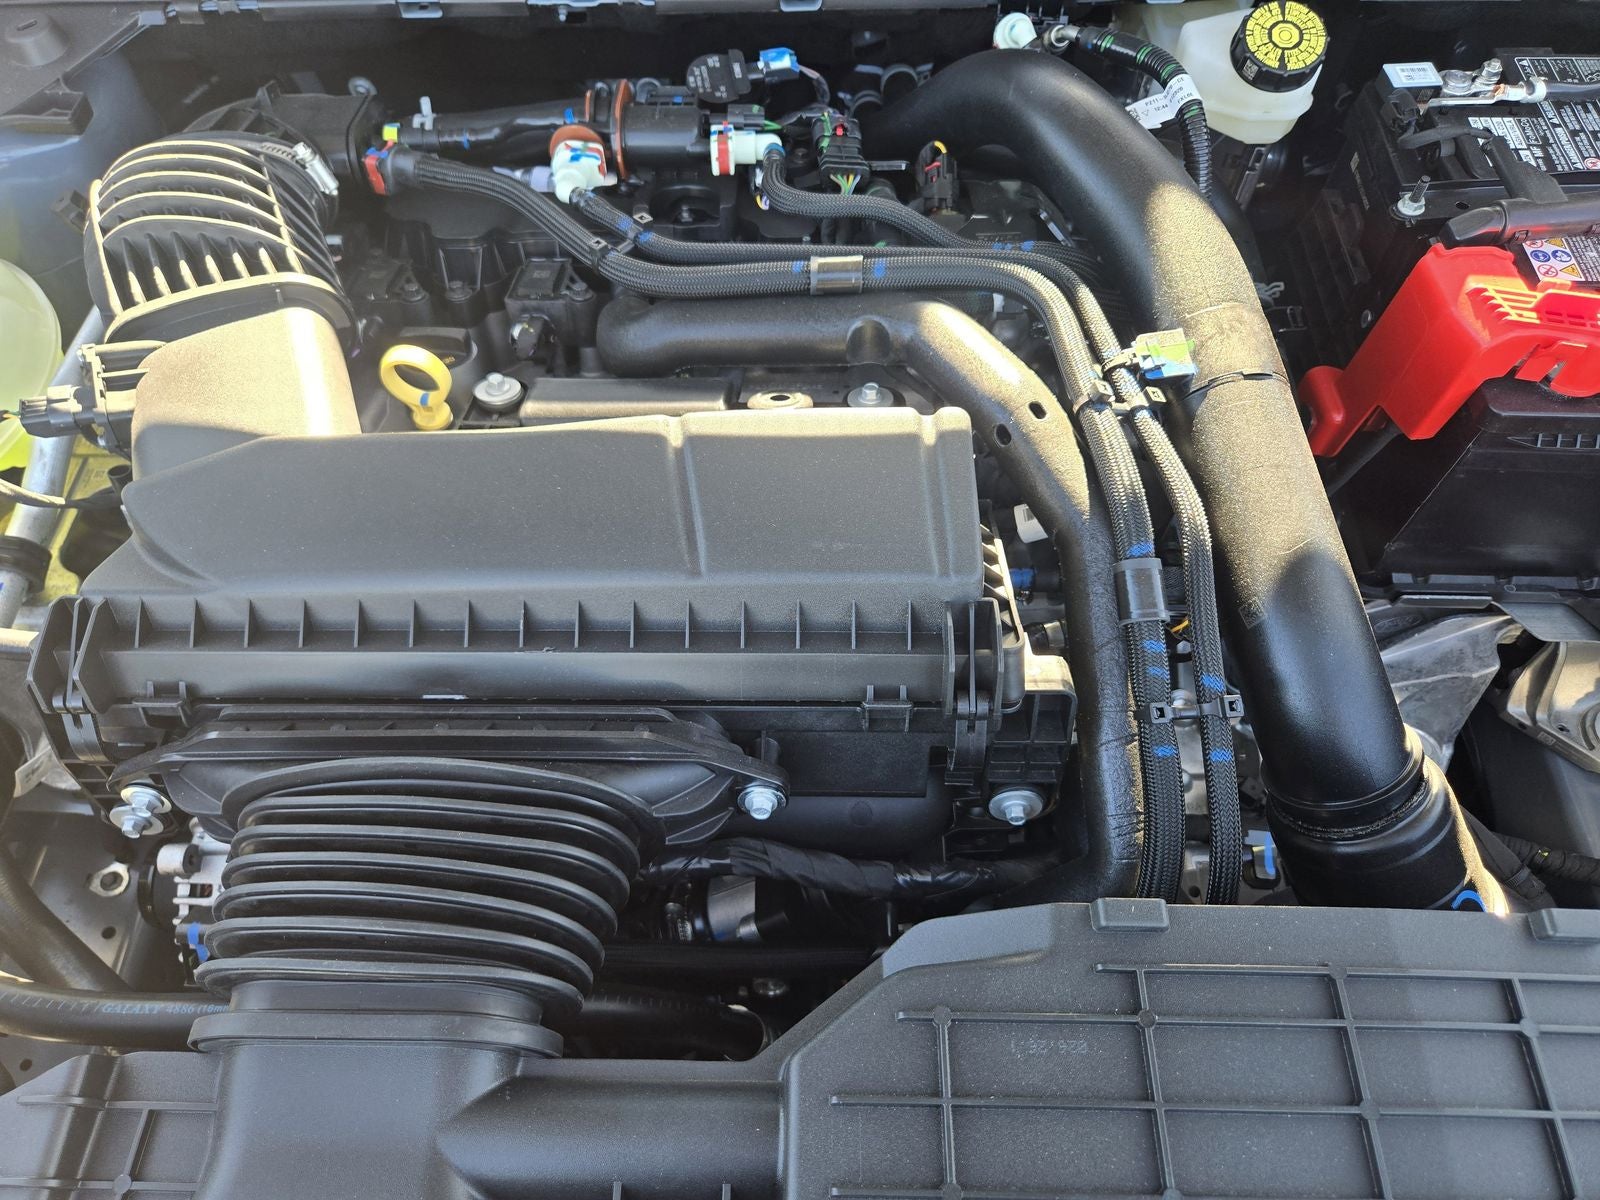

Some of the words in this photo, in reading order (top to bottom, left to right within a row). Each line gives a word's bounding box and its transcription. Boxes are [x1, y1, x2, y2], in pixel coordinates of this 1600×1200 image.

[1519, 118, 1538, 143] FoMoCo
[102, 1002, 161, 1014] GALAXY
[166, 1003, 194, 1014] 4886
